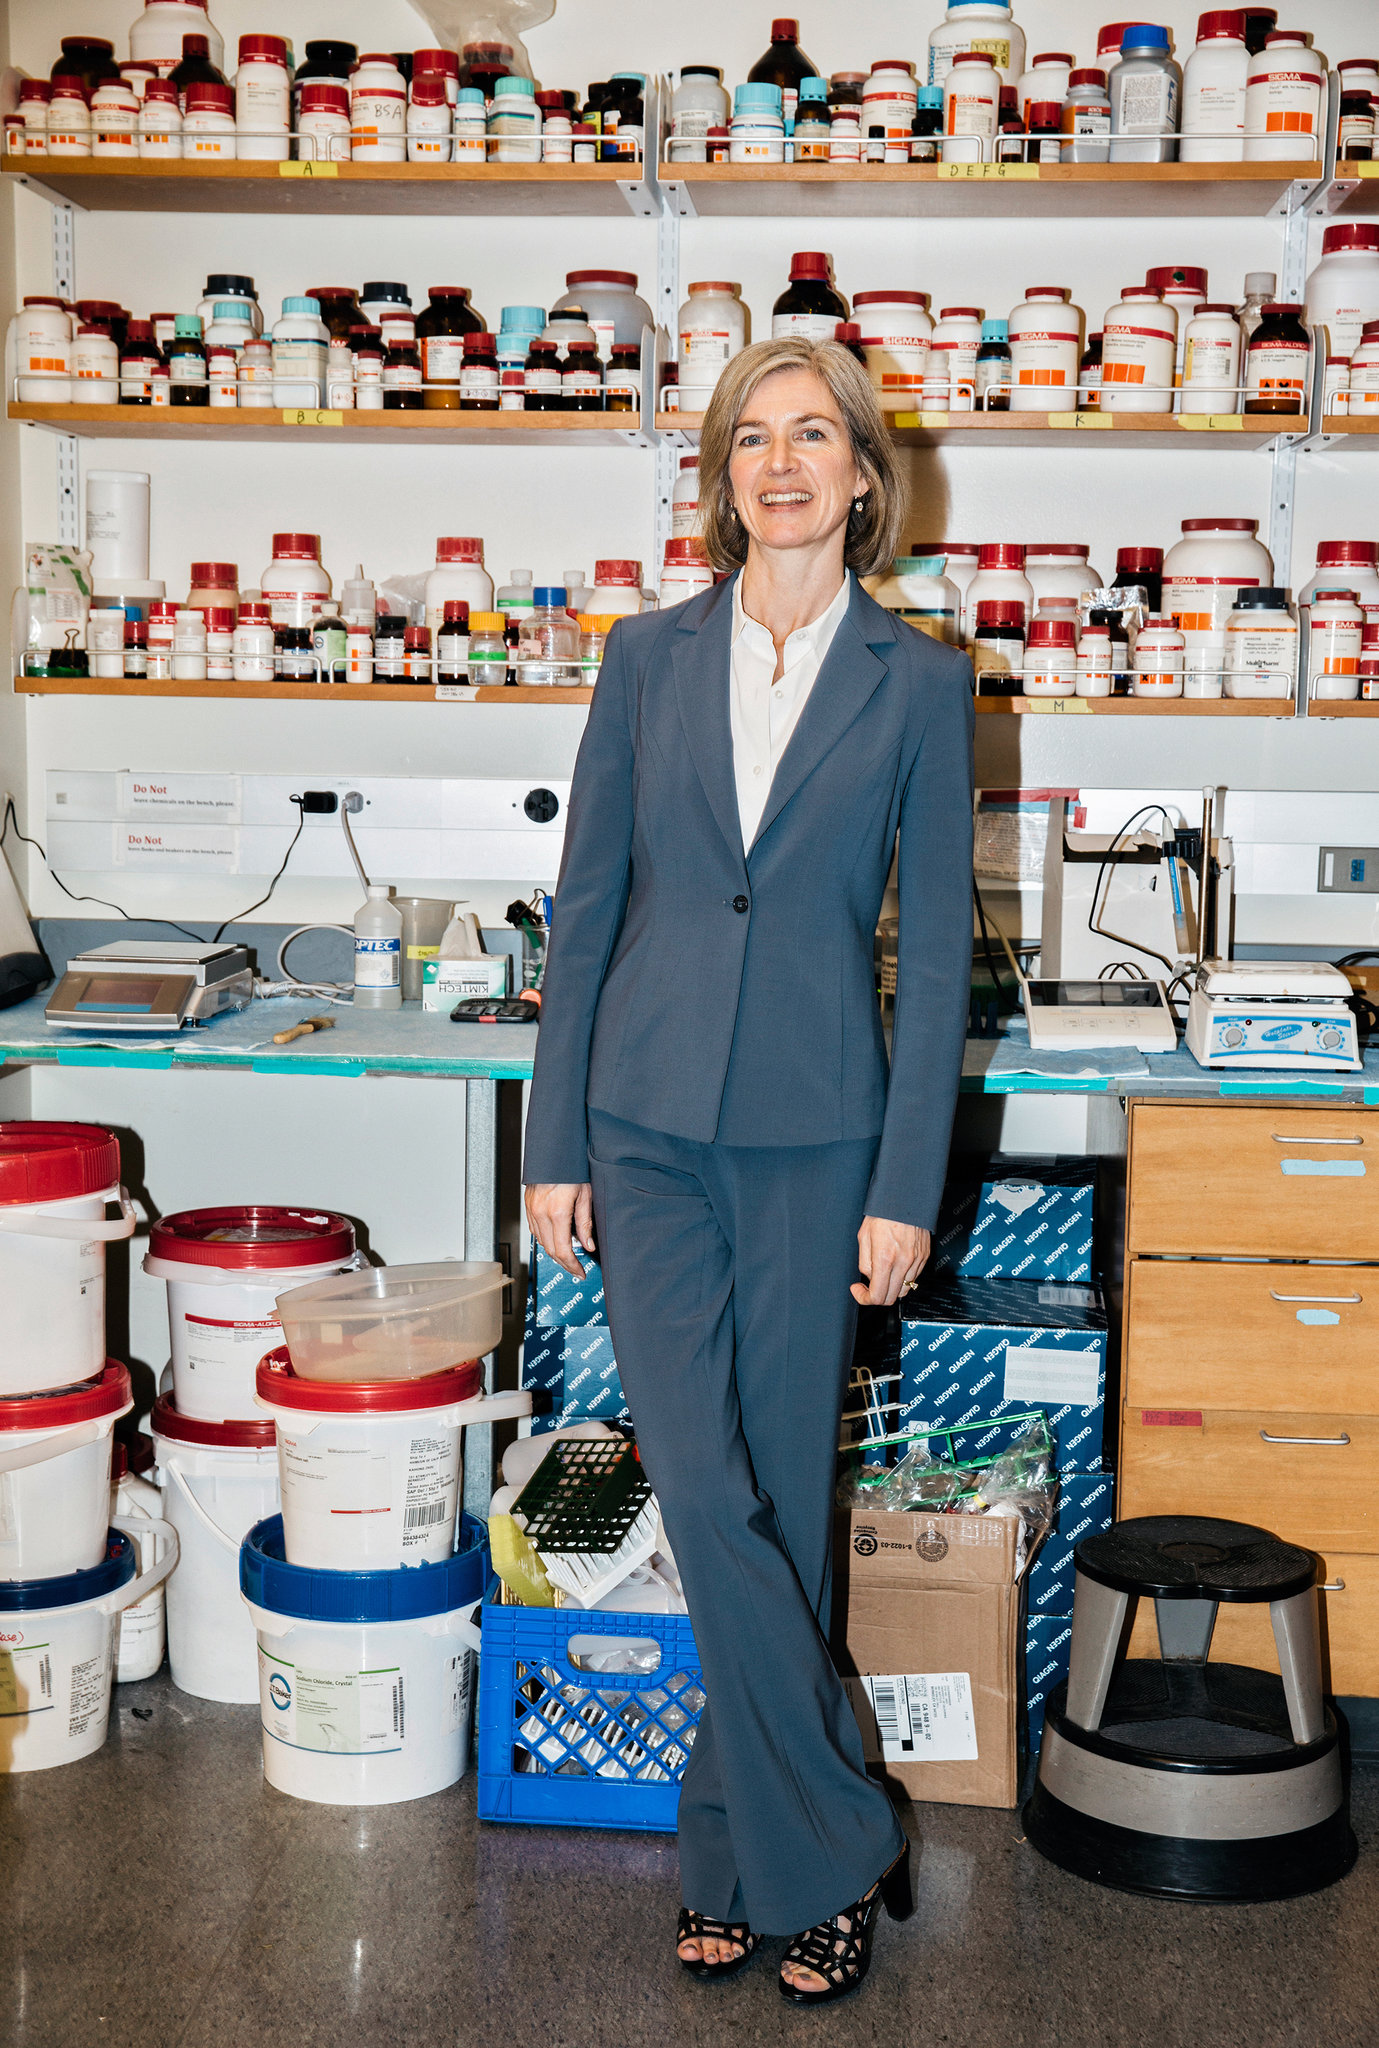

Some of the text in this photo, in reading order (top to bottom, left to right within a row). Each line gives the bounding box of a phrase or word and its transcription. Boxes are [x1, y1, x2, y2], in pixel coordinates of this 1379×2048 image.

[1268, 73, 1301, 81] SIGMA
[374, 104, 402, 119] BSA
[304, 162, 313, 175] A
[950, 164, 1006, 176] D E F G
[1019, 332, 1049, 341] SIGMA
[1106, 326, 1131, 334] SIGMA
[957, 341, 982, 350] SIGM
[297, 412, 324, 424] B C
[1075, 413, 1085, 428] K
[1209, 416, 1215, 429] L
[1172, 577, 1198, 585] SIGMA
[1053, 700, 1064, 712] M
[133, 784, 167, 794] Do Not
[196, 799, 215, 807] bench,
[128, 835, 162, 845] Do Not
[439, 984, 489, 993] KIMTECH
[1037, 1191, 1063, 1214] QIAGEN
[972, 1212, 997, 1236] QIAGEN
[1024, 1222, 1049, 1246] QIAGEN
[1057, 1211, 1083, 1235] QIAGEN
[959, 1243, 983, 1267] QIAGEN
[991, 1232, 1017, 1256] QIAGEN
[1044, 1242, 1069, 1266] QIAGEN
[1011, 1253, 1036, 1276] QIAGEN
[540, 1272, 564, 1296] QIAGEN
[559, 1292, 584, 1316] QIAGEN
[233, 1320, 282, 1328] SIGMA-ALDRIC
[580, 1336, 604, 1360] QIAGEN
[928, 1327, 955, 1352] QIAGEN
[983, 1338, 1010, 1363] QIAGEN
[527, 1348, 551, 1370] QIAGEN
[948, 1349, 976, 1374] QIAGEN
[567, 1367, 592, 1391] QIAGEN
[913, 1360, 940, 1385] QIAGEN
[969, 1371, 996, 1396] QIAGEN
[587, 1387, 611, 1411] QIAGEN
[899, 1393, 926, 1417] QIAGEN
[933, 1382, 961, 1407] QIAGEN
[974, 1426, 1002, 1450] QIAGEN
[1065, 1426, 1093, 1451] QIAGEN
[1080, 1484, 1107, 1509] QIAGEN
[1066, 1516, 1093, 1541] QIAGEN
[880, 1542, 913, 1550] 8-1022-03
[1036, 1581, 1063, 1605] QIAGEN
[0, 1630, 25, 1645] ase)
[296, 1675, 312, 1683] Sodium
[313, 1677, 334, 1687] Chloride,
[1032, 1660, 1059, 1684] QIAGEN
[921, 1703, 928, 1711] CA
